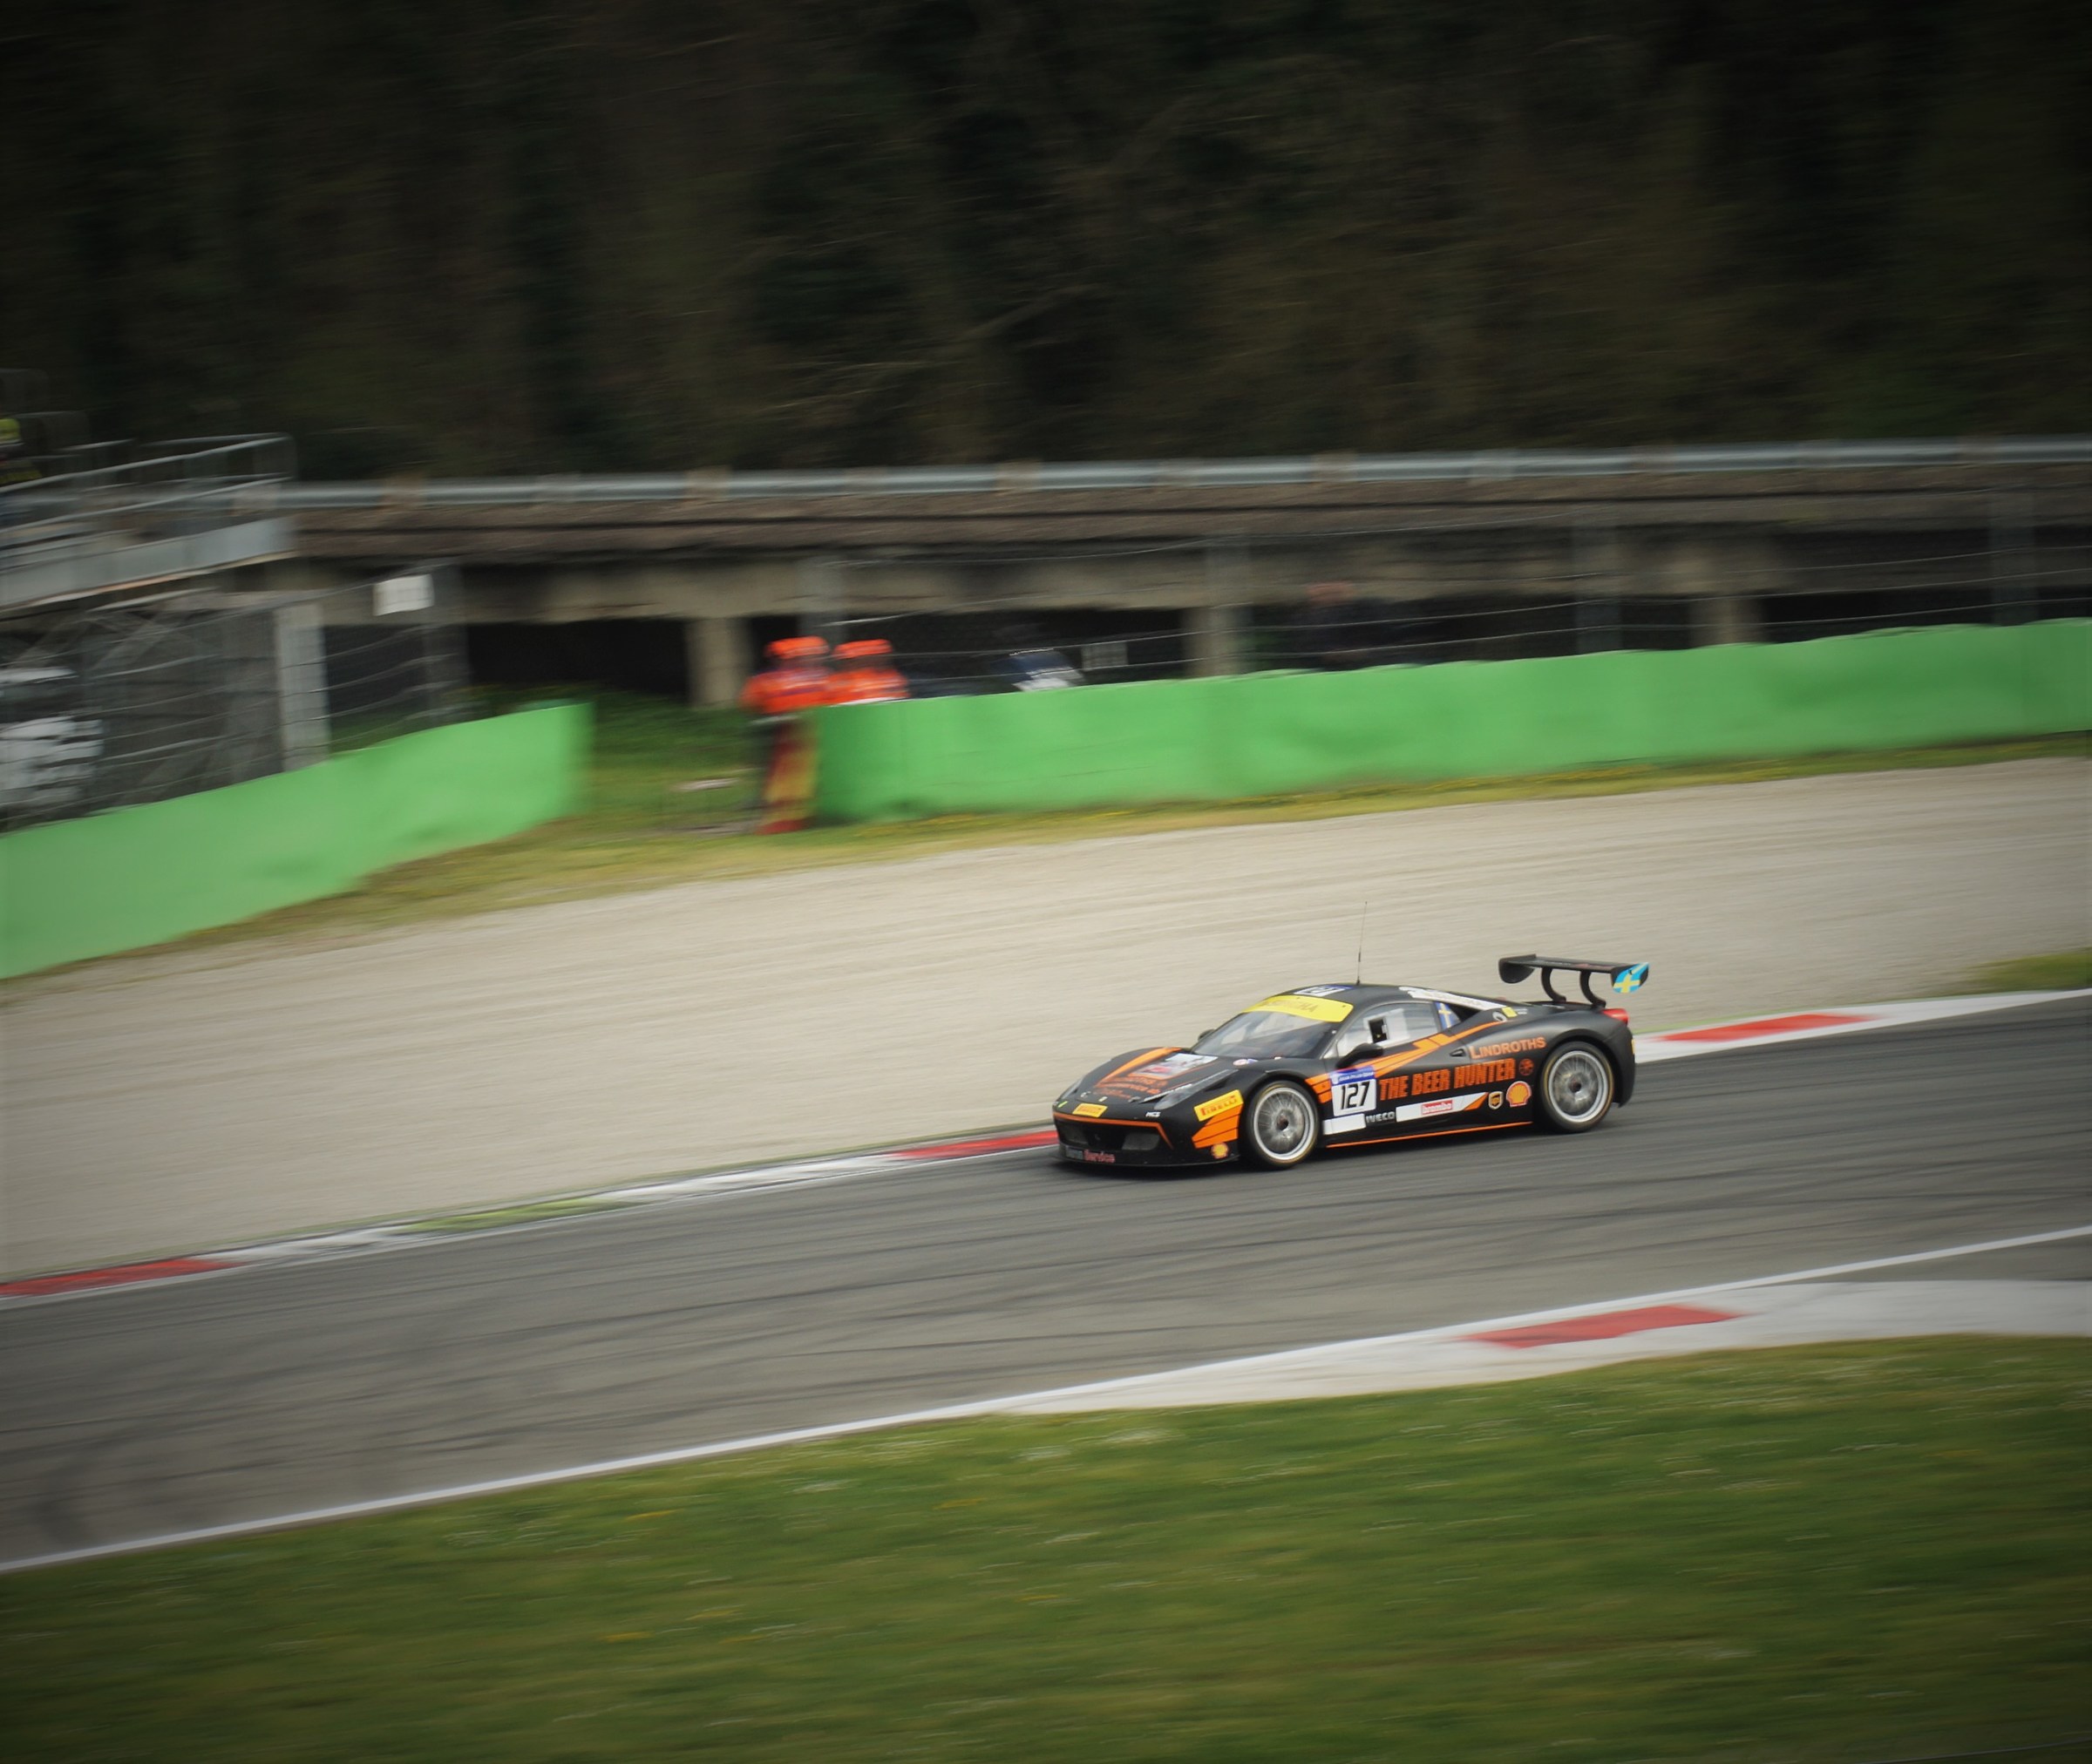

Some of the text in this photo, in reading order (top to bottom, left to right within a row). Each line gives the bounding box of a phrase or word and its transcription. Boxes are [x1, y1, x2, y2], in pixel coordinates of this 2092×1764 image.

[1469, 1036, 1547, 1060] LINDROTHS
[1379, 1057, 1516, 1102] THE BEER HUNTER
[1340, 1081, 1370, 1110] 127
[1365, 1111, 1396, 1123] IVECO
